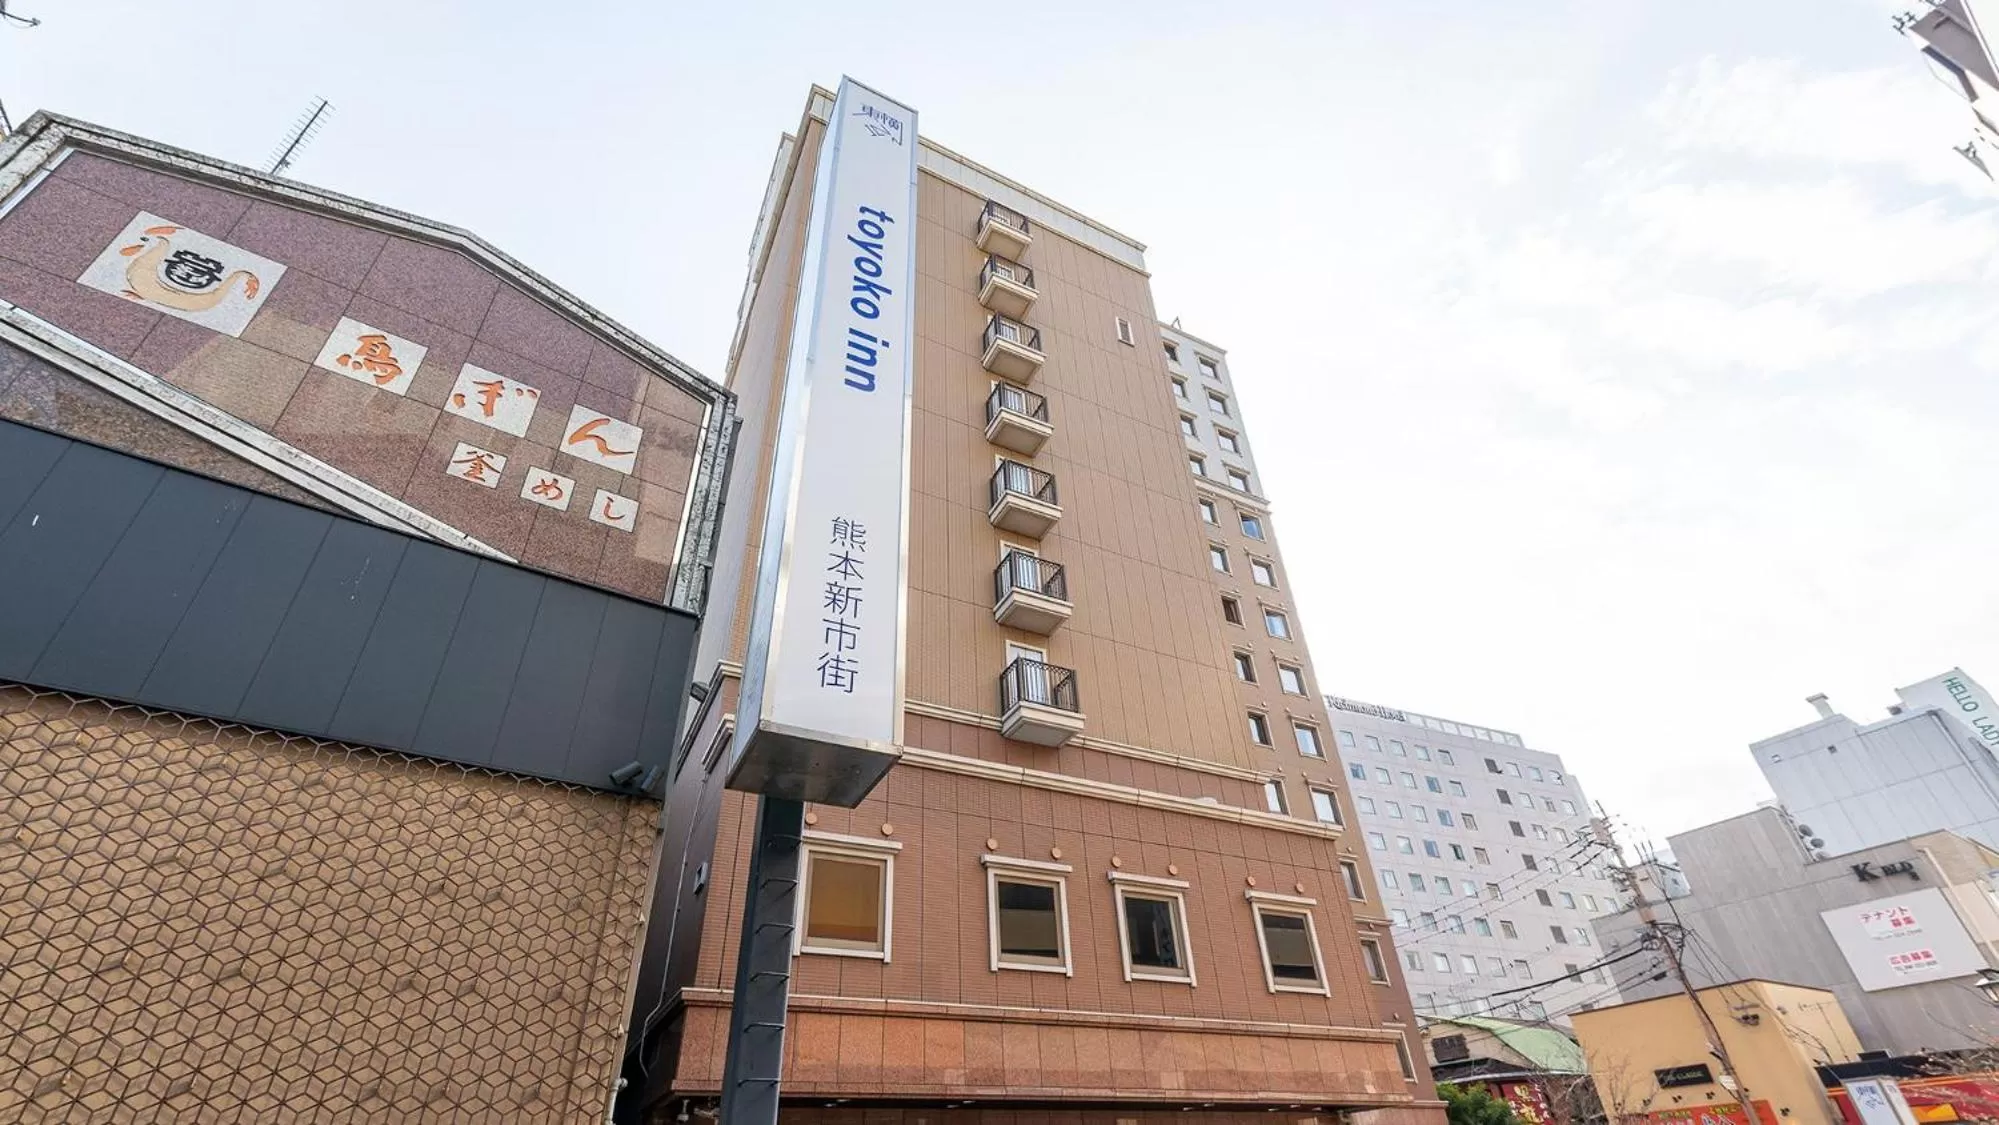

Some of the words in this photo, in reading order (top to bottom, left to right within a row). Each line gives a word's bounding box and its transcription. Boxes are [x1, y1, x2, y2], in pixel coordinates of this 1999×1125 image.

[847, 205, 895, 320] toyoko
[844, 326, 890, 393] inn
[452, 450, 625, 520] 釜めし
[816, 516, 867, 694] 熊本新市街
[1941, 677, 1979, 712] HELLO
[1850, 862, 1880, 882] K
